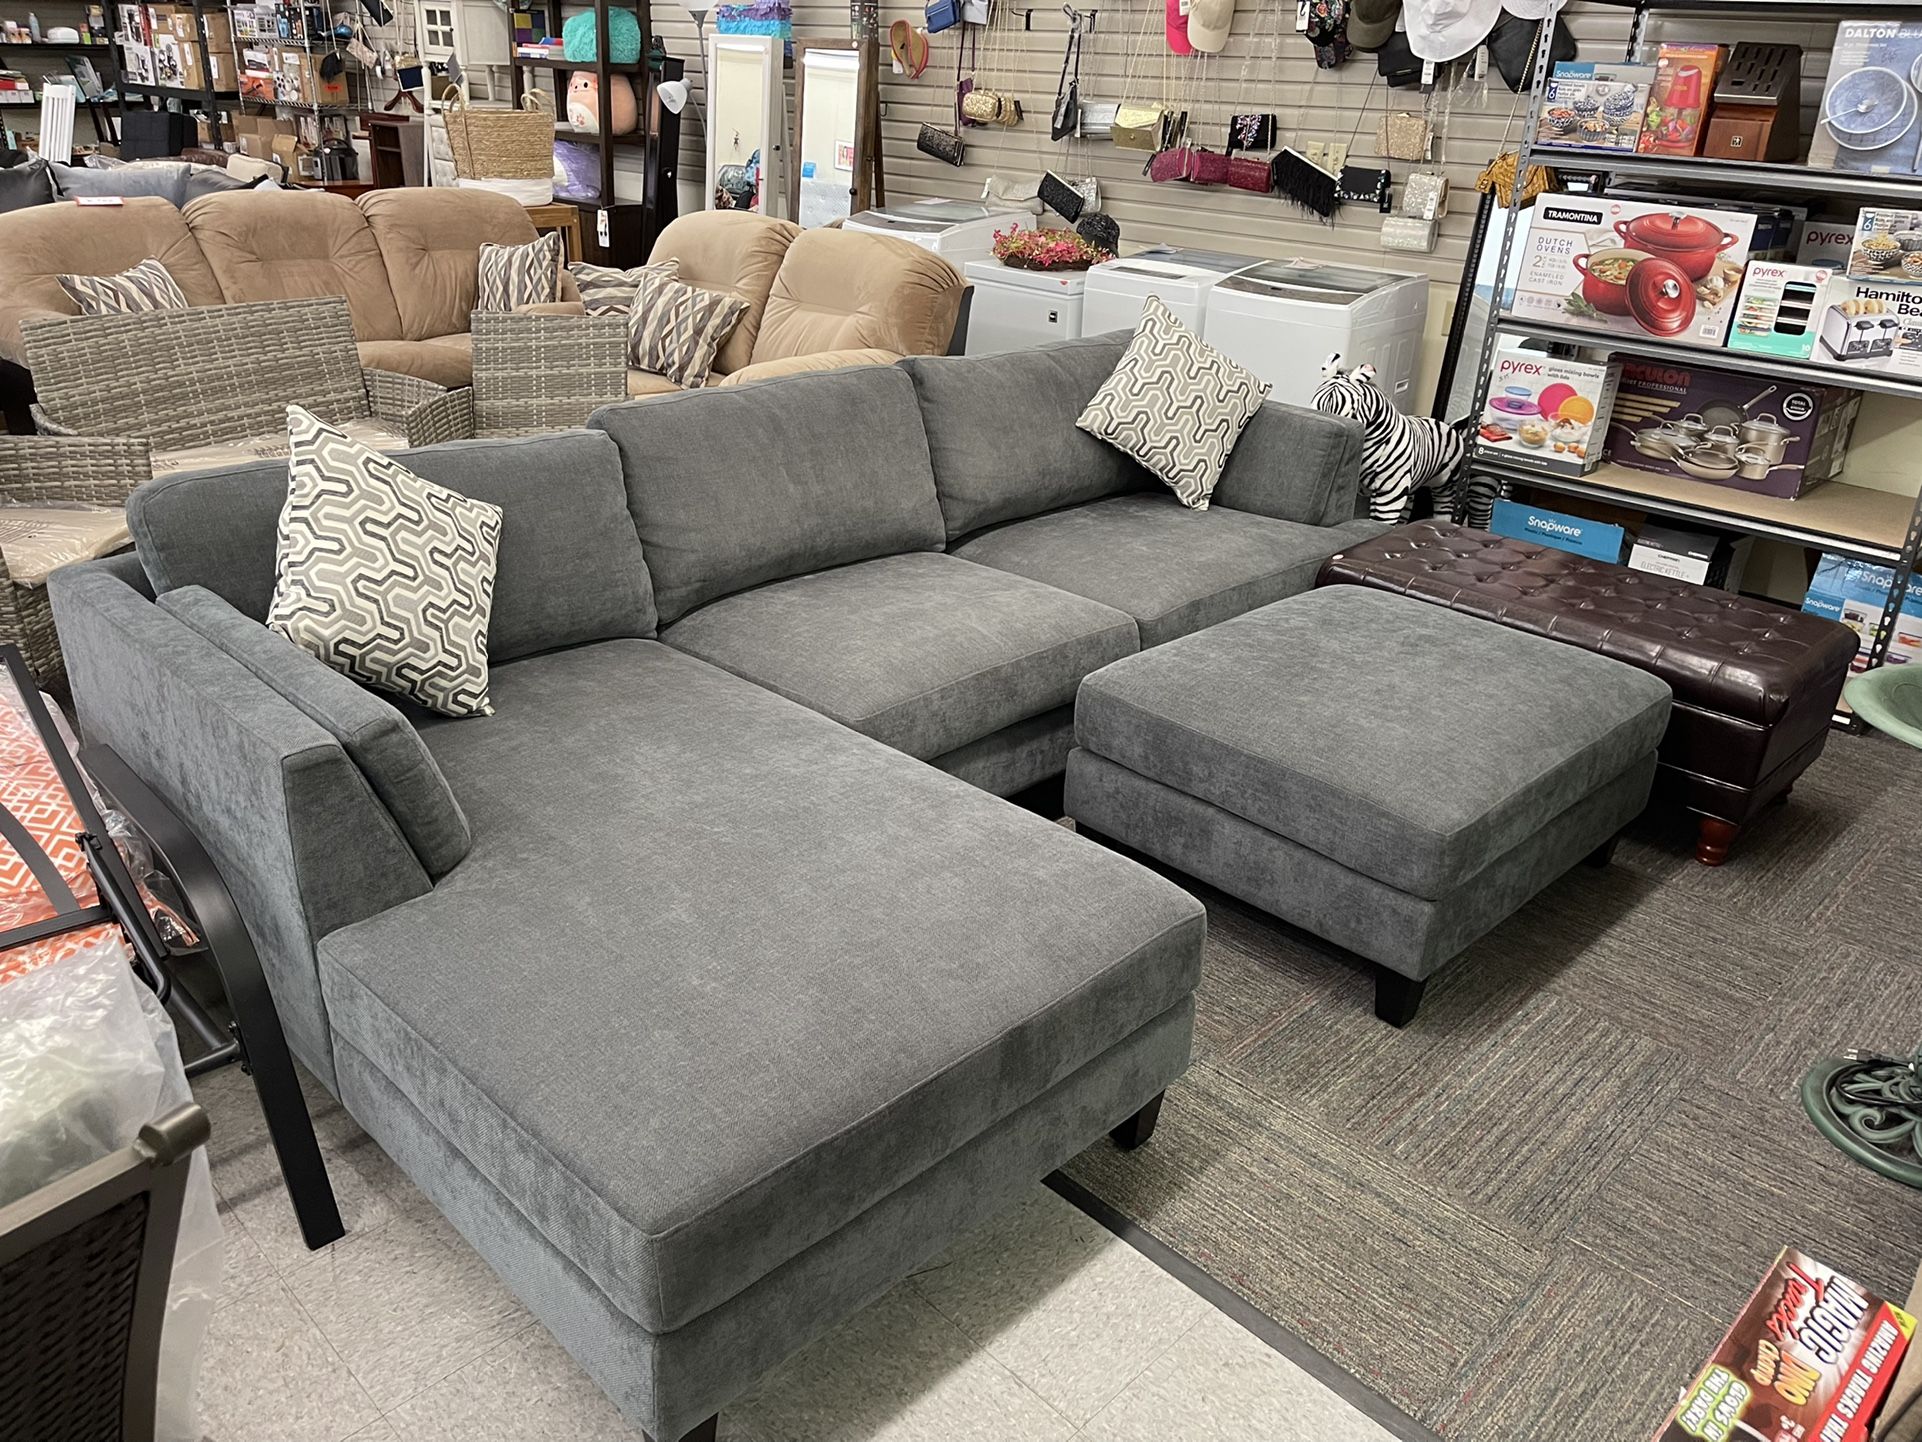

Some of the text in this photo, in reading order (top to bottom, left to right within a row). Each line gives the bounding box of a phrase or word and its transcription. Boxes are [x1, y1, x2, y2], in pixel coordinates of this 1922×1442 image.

[1844, 28, 1897, 39] DALTON
[1548, 88, 1556, 99] 6
[1548, 210, 1598, 223] TRAMONTINA
[1863, 219, 1872, 230] 6
[1537, 236, 1574, 247] DUTCH
[1806, 231, 1855, 246] pyrex
[1536, 244, 1571, 255] OVENS
[1532, 254, 1541, 268] 2
[1752, 266, 1786, 278] pyrex
[1500, 360, 1543, 376] pyrex
[1478, 446, 1485, 455] 8
[1528, 515, 1582, 537] Snapware
[1805, 597, 1840, 612] Snapware
[1766, 1261, 1826, 1341] Tracks
[1799, 1275, 1870, 1365] MAGIC
[1861, 1319, 1900, 1374] AMAZING
[1682, 1367, 1730, 1433] THE DARK!
[1836, 1369, 1873, 1419] TRACKS
[1702, 1379, 1748, 1442] GLOWS IN
